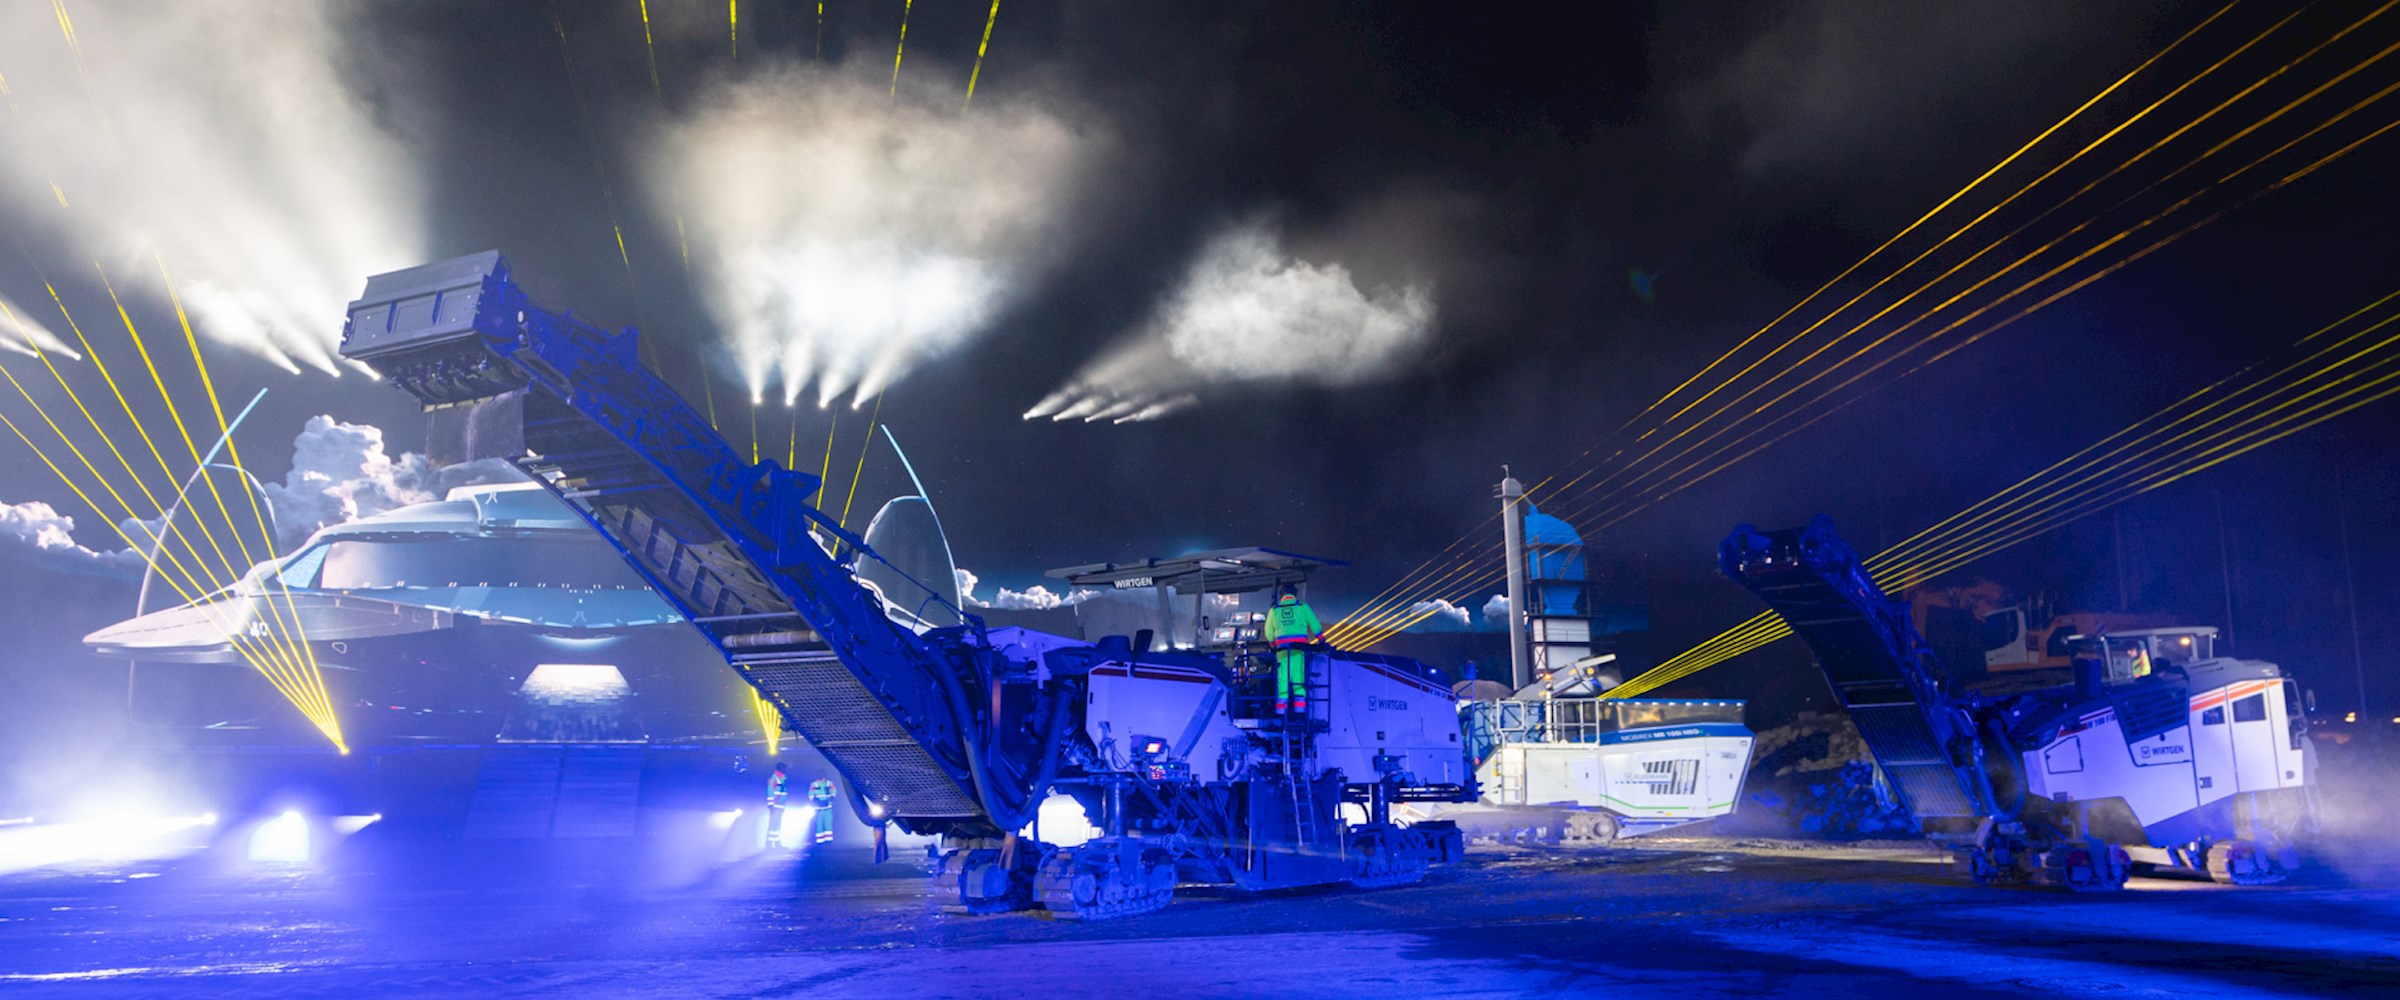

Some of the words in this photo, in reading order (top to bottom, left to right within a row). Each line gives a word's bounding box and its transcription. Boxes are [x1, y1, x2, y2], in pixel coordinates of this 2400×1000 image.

[1113, 576, 1153, 589] WIRTGEN
[1379, 699, 1407, 710] WIRTGEN
[2151, 745, 2183, 755] WIRTGEN
